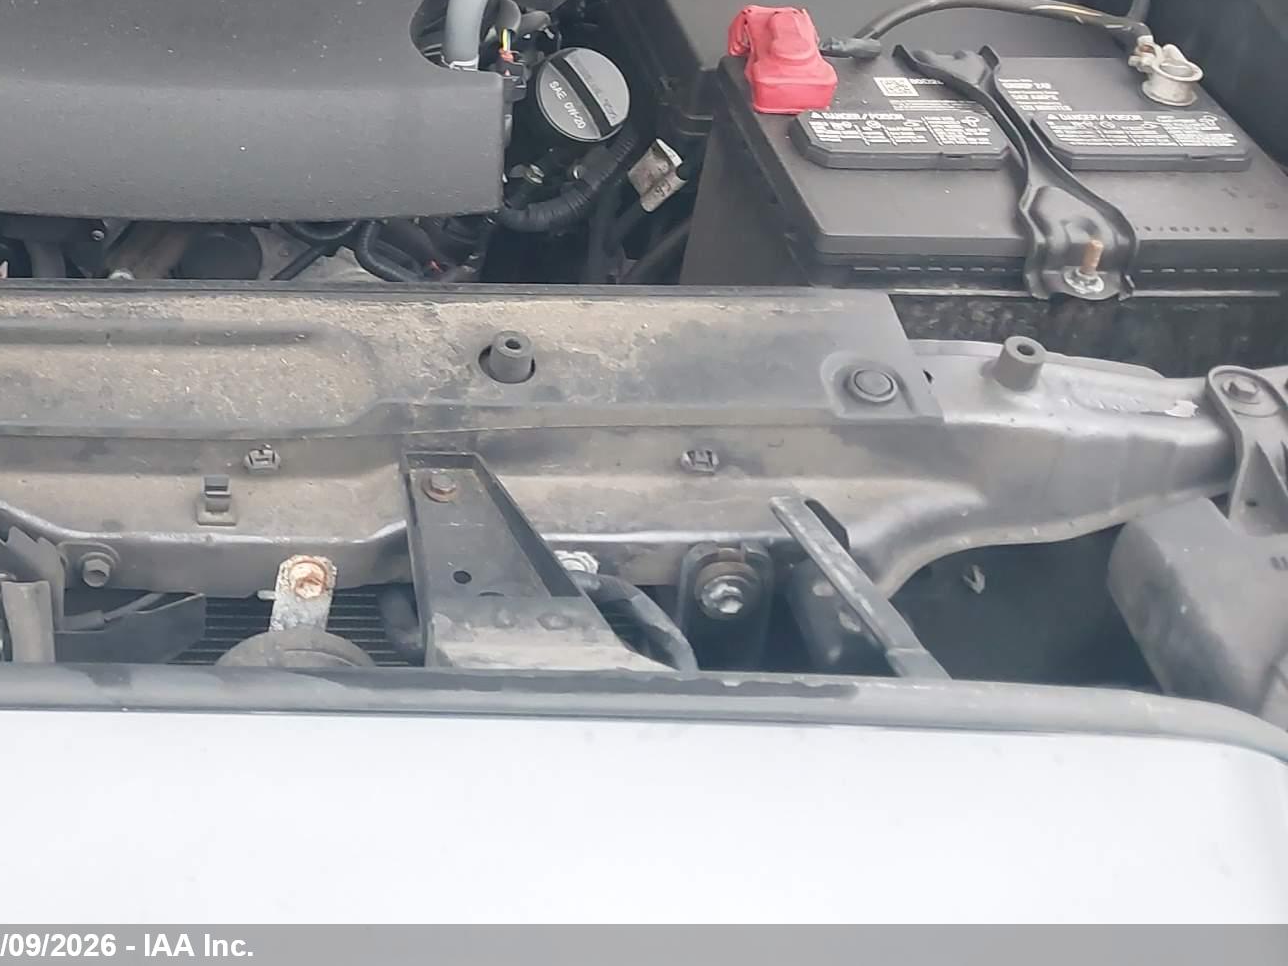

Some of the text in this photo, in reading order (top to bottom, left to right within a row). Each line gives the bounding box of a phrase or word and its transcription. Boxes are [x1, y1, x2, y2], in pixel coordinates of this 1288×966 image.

[549, 80, 567, 100] SAE
[823, 113, 861, 121] DANGER
[868, 113, 905, 121] POISON
